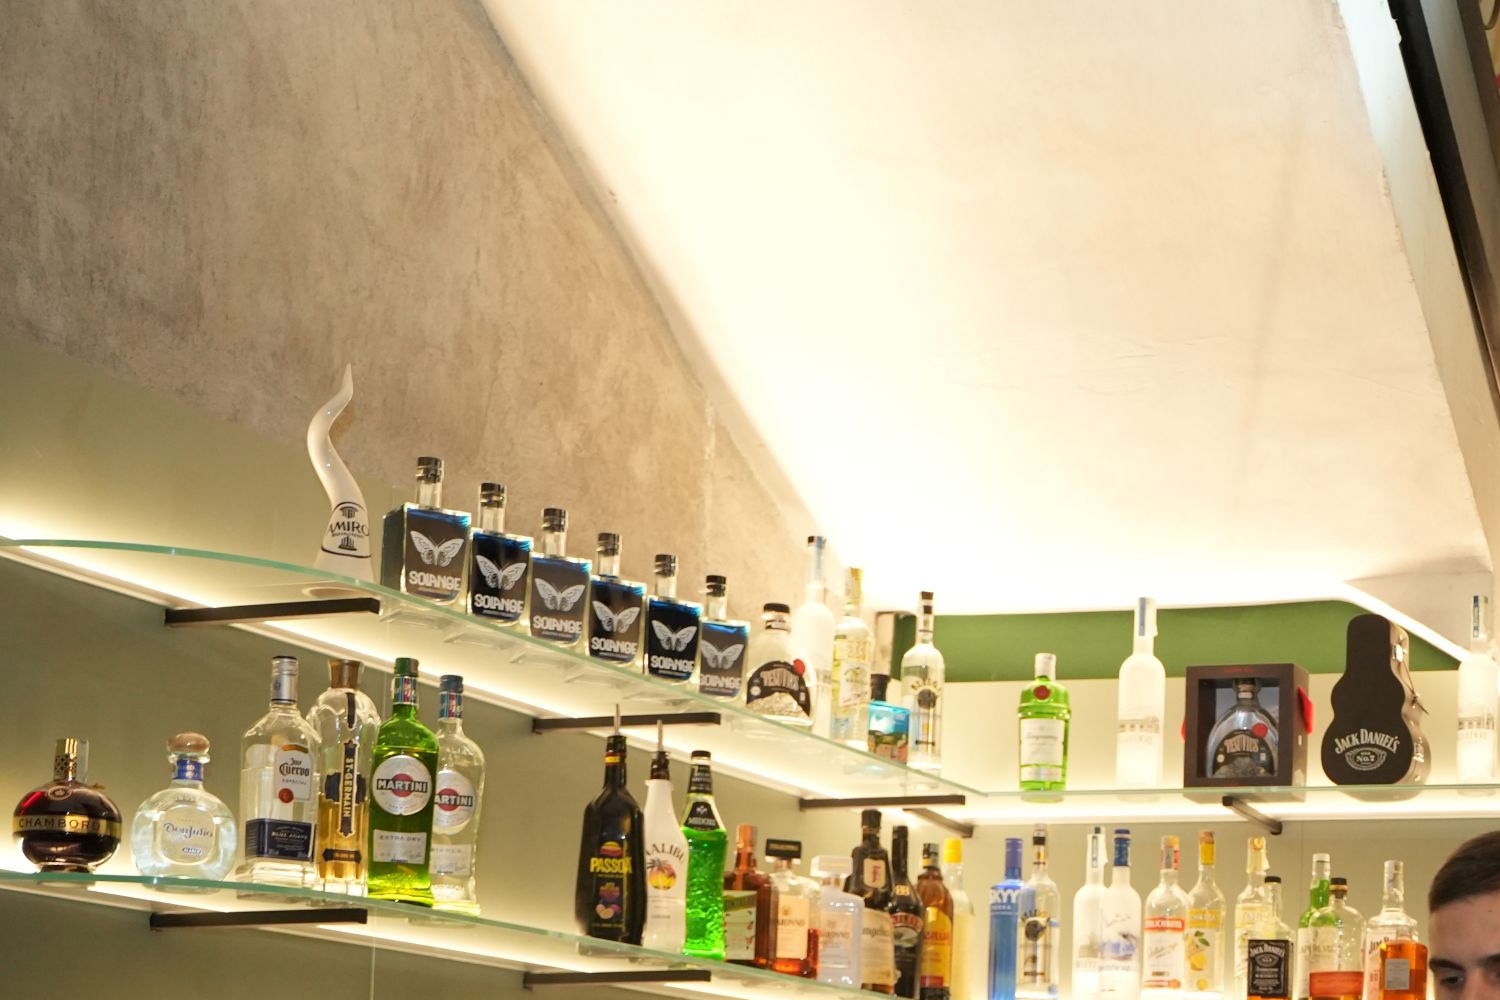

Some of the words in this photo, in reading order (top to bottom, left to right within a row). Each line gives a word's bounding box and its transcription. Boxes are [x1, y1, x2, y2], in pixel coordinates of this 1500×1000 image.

[1334, 733, 1360, 754] JACK
[1360, 728, 1400, 754] DANIEL'S
[279, 762, 310, 777] Cuervo
[378, 779, 428, 792] MARTINI
[435, 795, 473, 807] ARTINI
[18, 817, 100, 831] CHAMBORD
